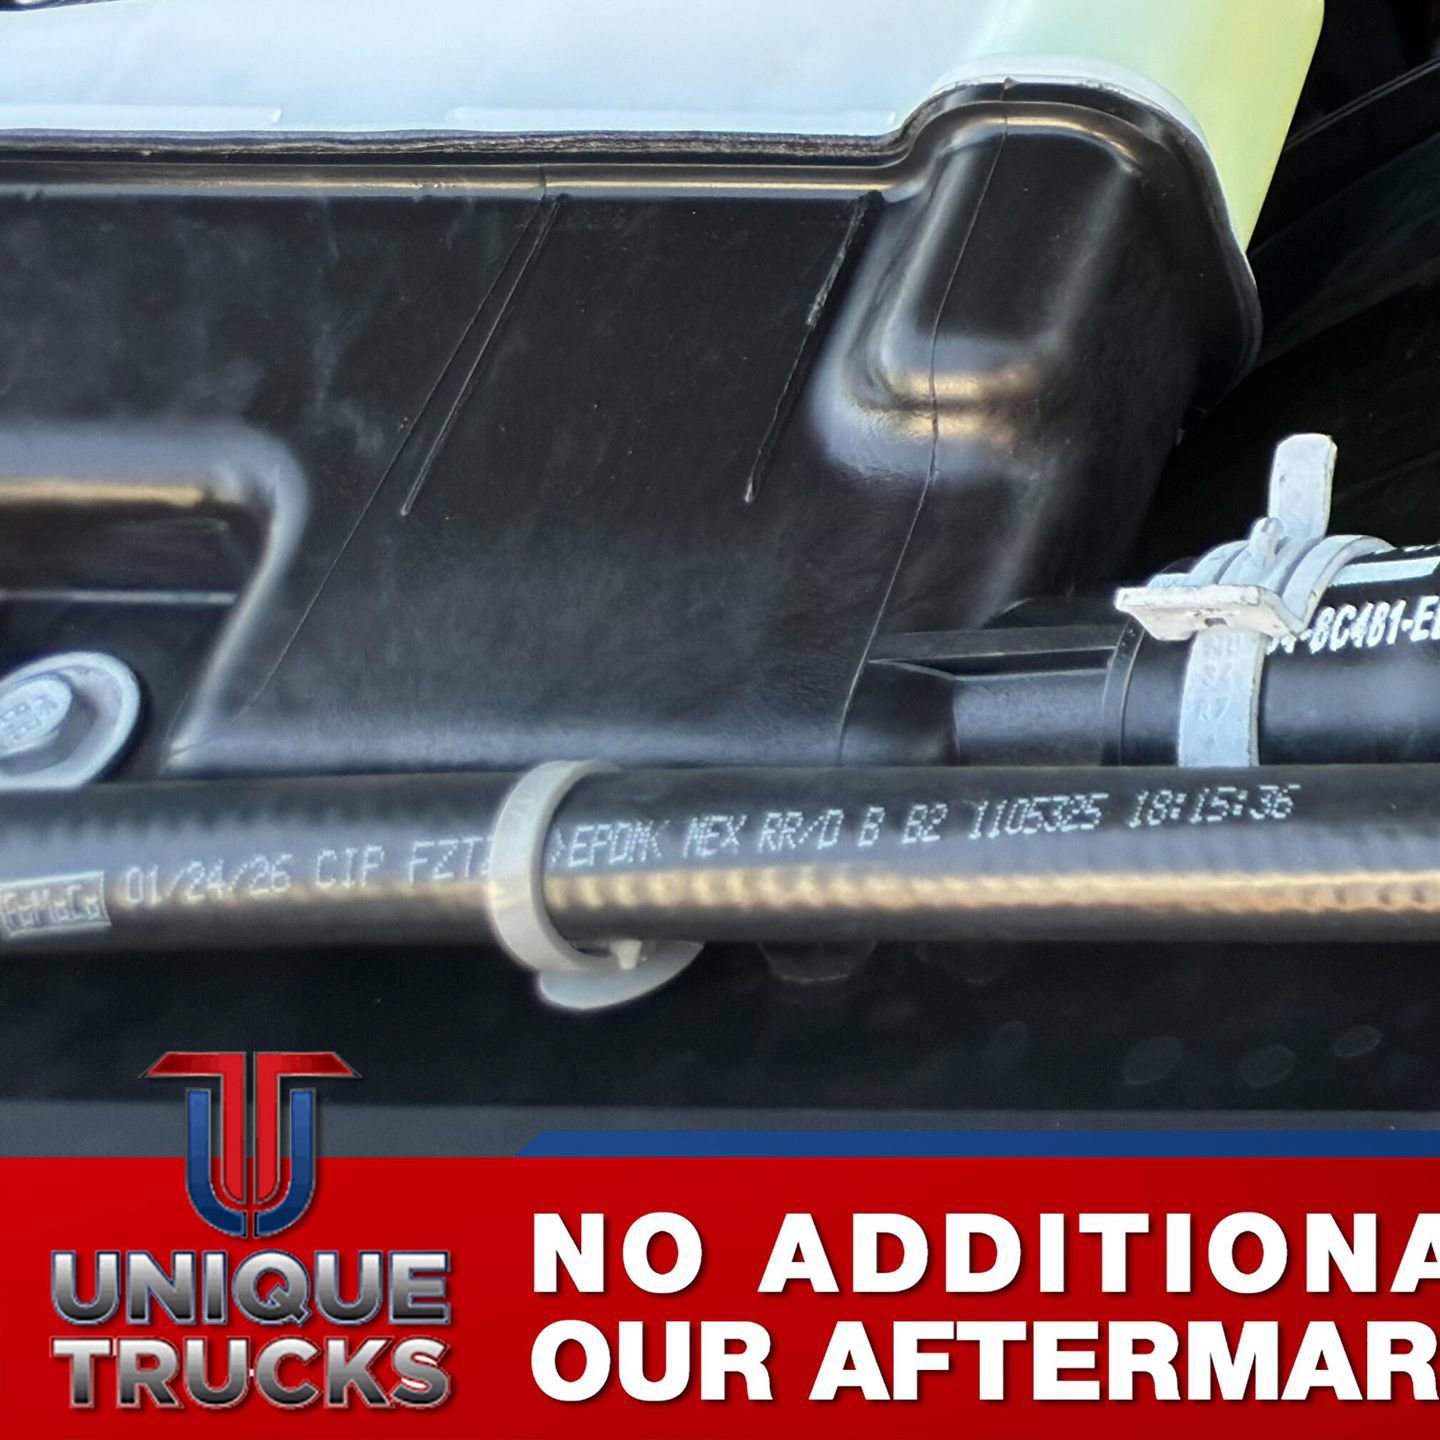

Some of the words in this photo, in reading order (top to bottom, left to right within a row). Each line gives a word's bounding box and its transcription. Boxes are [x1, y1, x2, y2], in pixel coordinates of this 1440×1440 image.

[124, 852, 292, 908] 01/24/26
[315, 844, 385, 889] CIP
[683, 814, 749, 858] MEX
